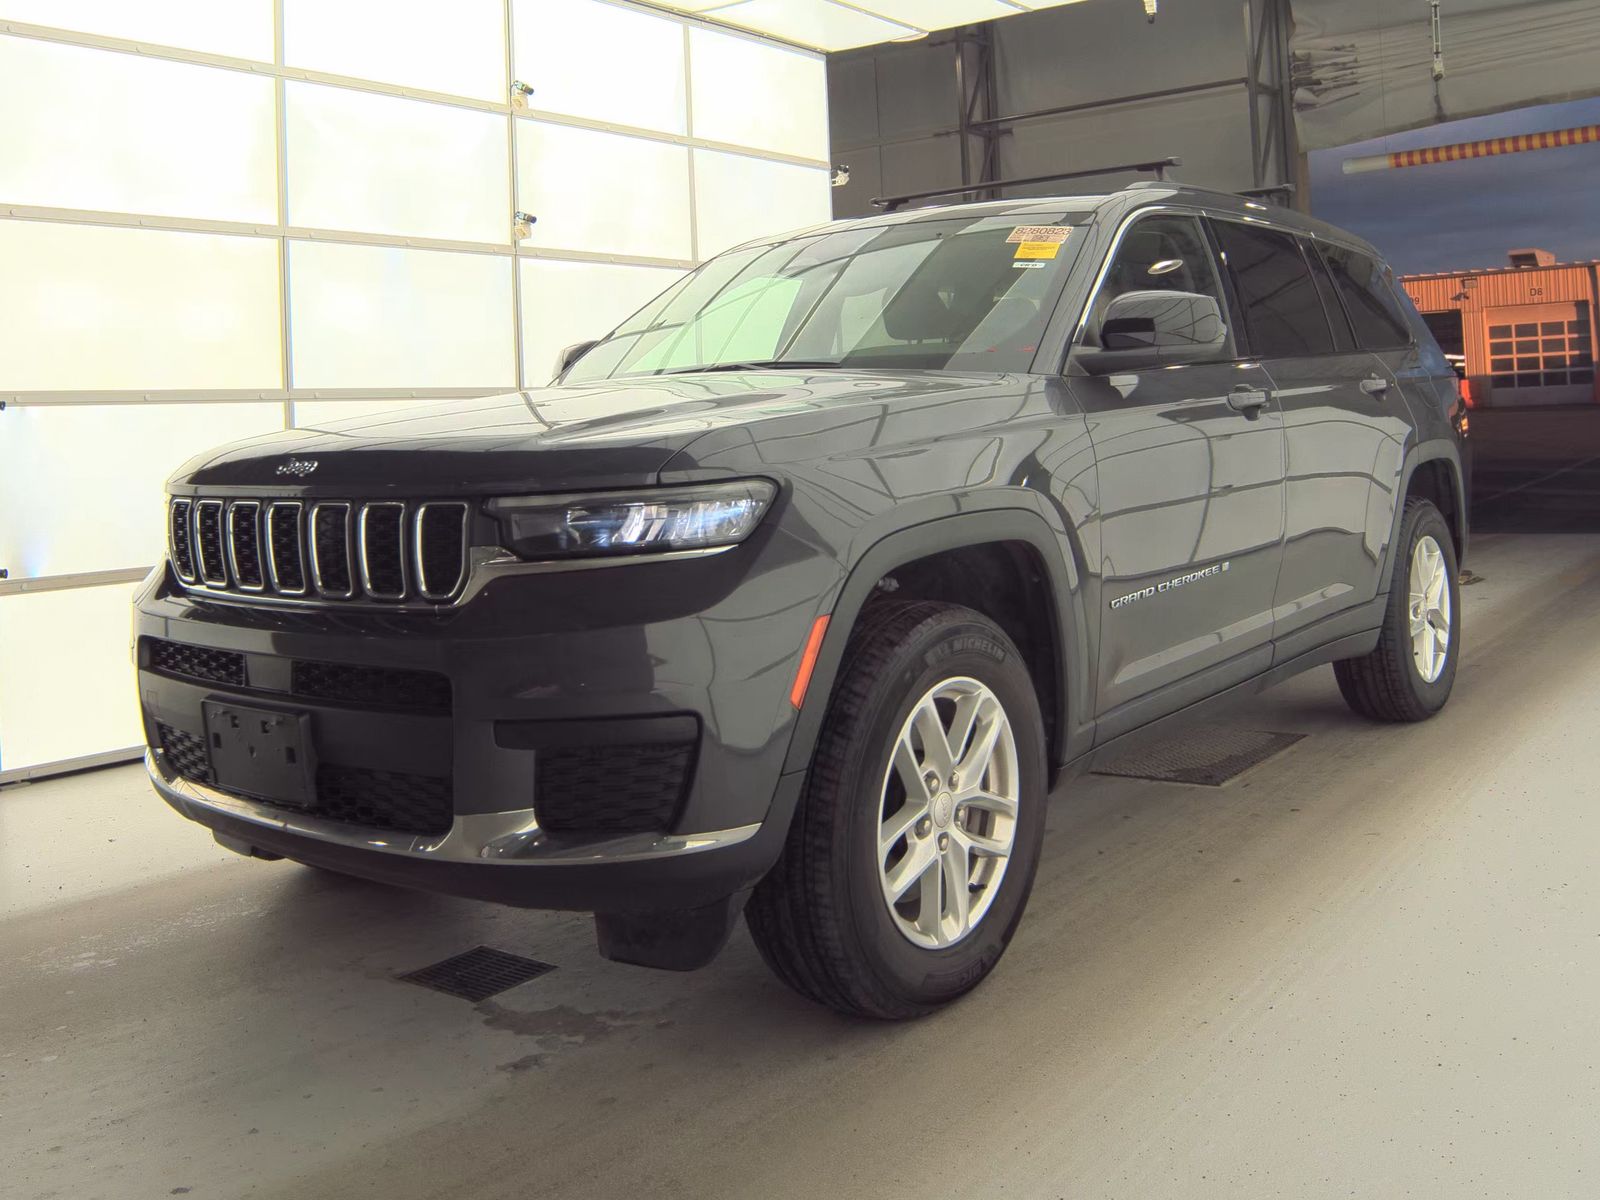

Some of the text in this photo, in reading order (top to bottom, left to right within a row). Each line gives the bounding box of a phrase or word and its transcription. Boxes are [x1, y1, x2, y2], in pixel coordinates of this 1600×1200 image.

[1109, 586, 1155, 609] GRAND
[1157, 564, 1220, 593] CHEROKEE
[952, 638, 1006, 661] MICHELIN
